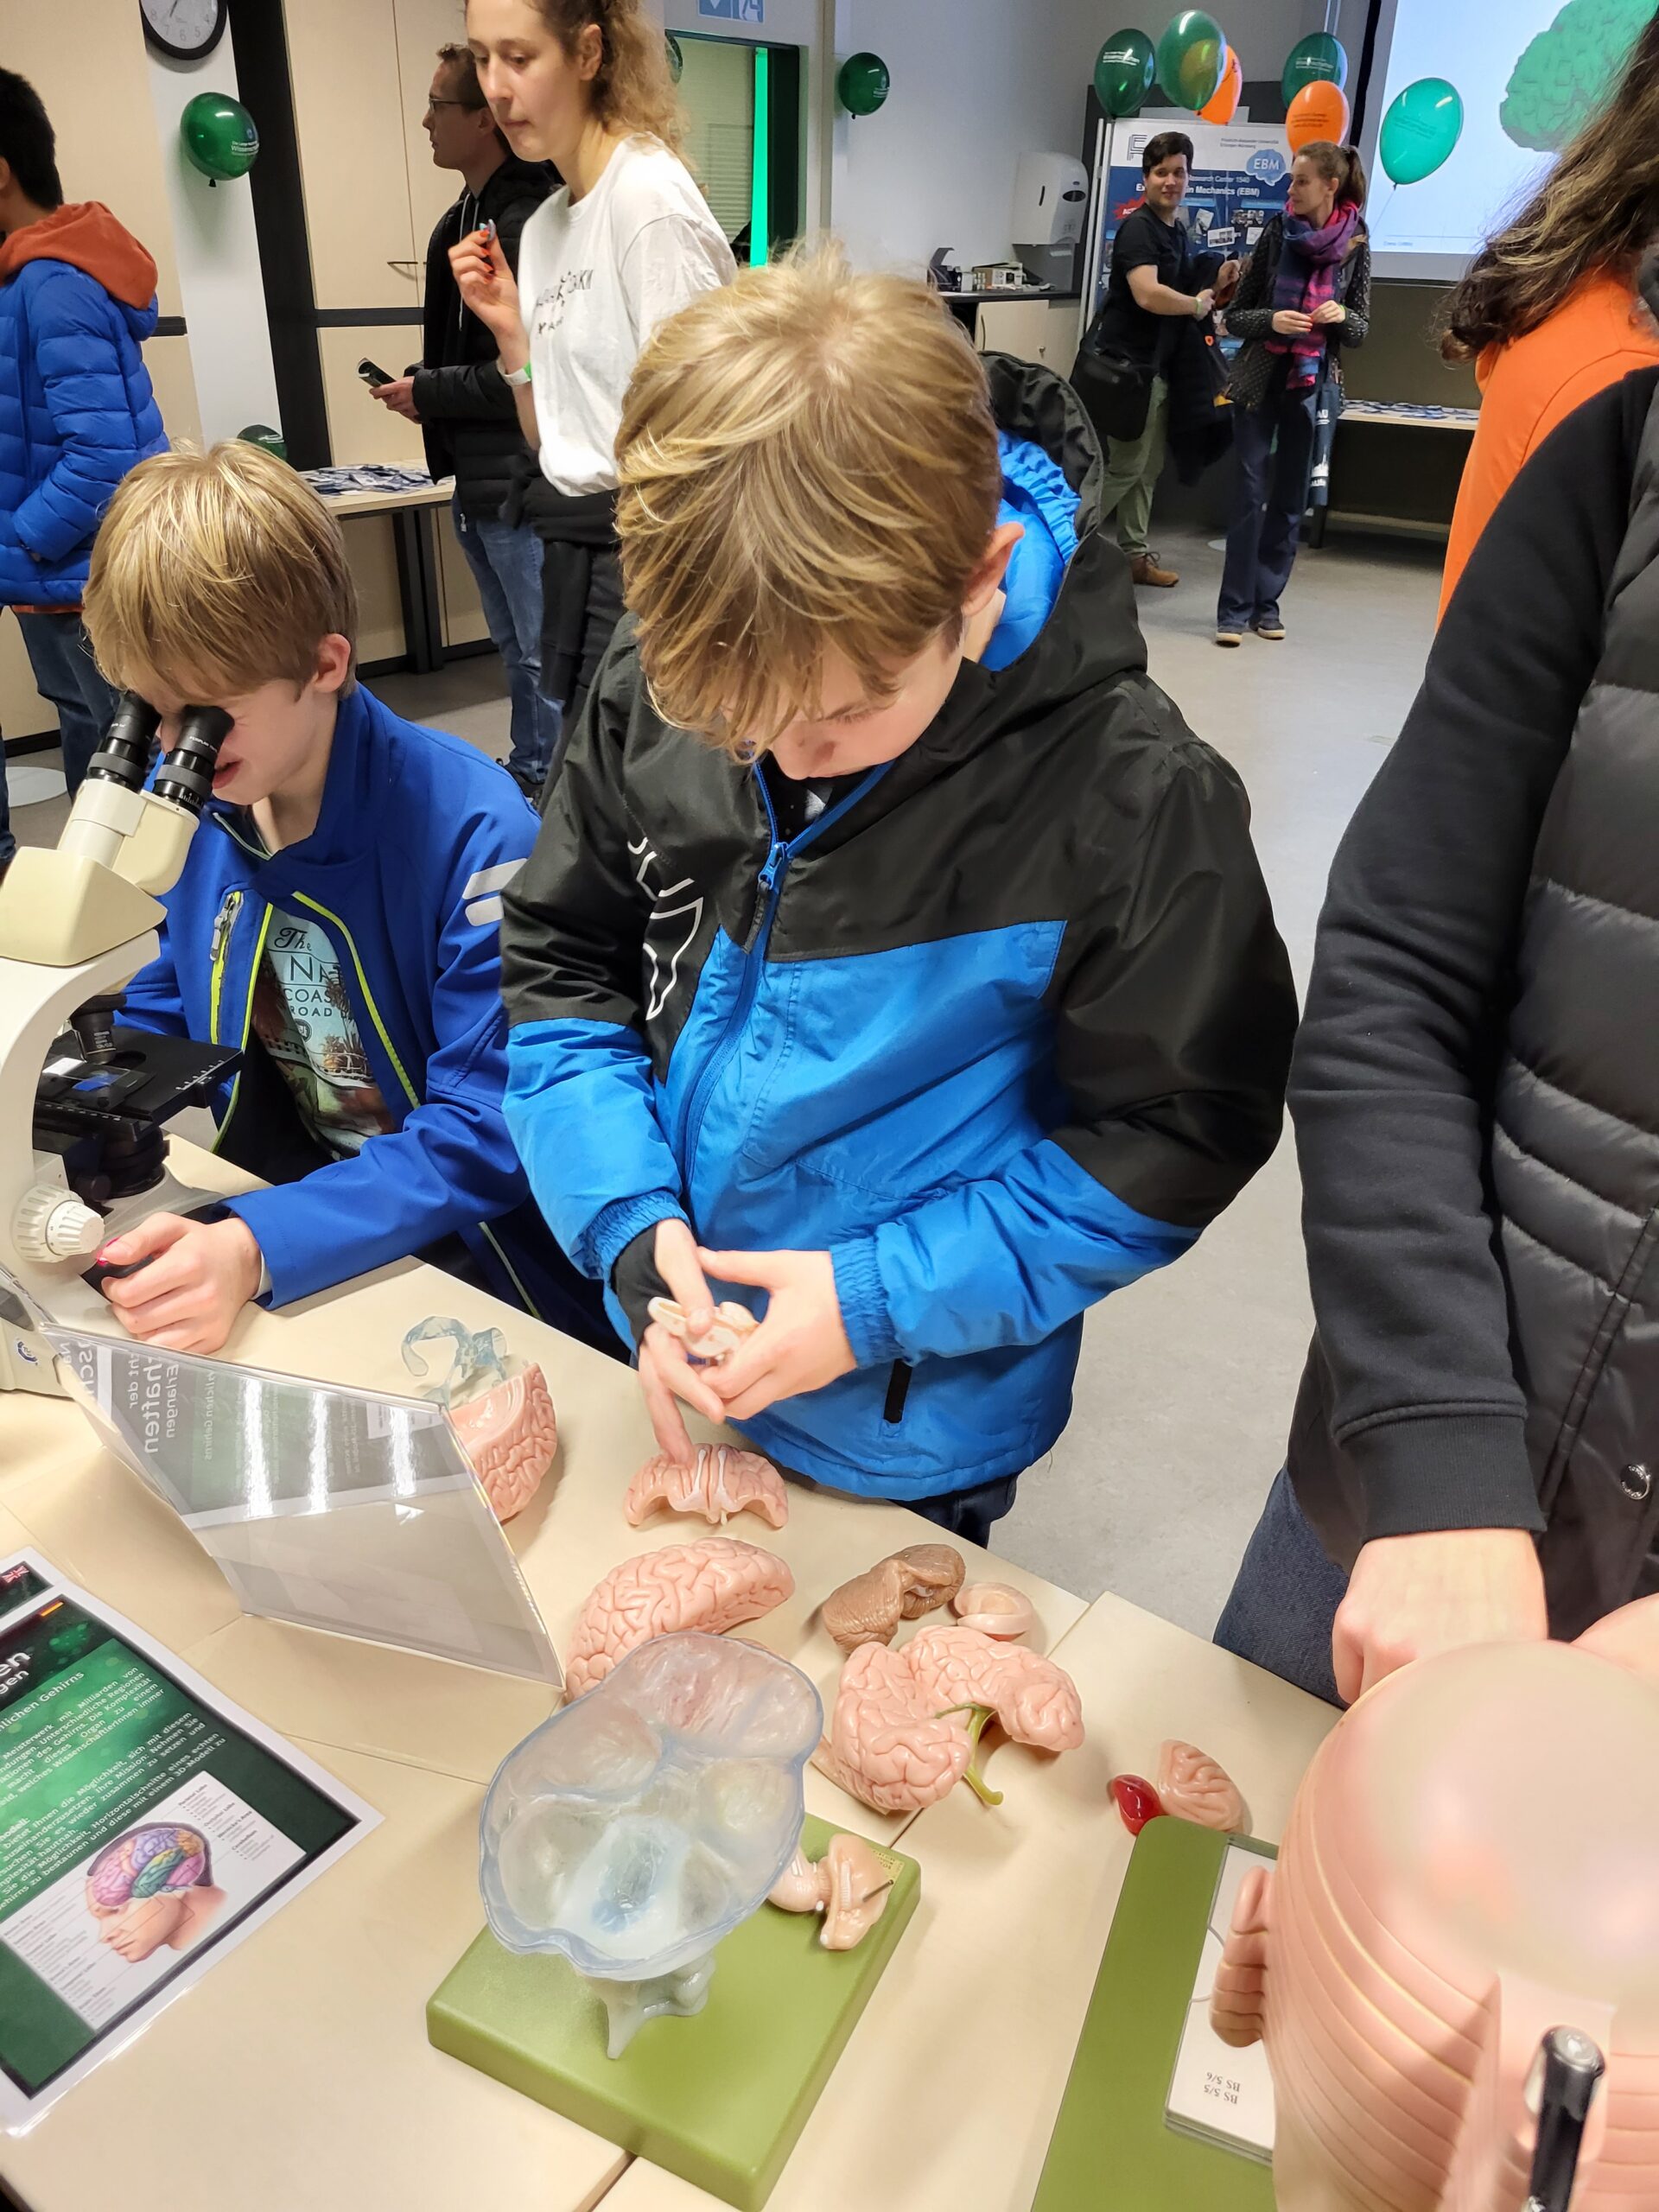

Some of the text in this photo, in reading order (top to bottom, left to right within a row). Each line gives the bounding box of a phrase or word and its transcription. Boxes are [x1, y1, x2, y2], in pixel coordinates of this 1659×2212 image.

[1195, 186, 1236, 195] Mechanics
[1236, 187, 1261, 197] (EBM)
[1254, 158, 1280, 171] EBM
[274, 927, 312, 951] The
[0, 1667, 138, 1760] Meisterwerk mit Milliarden von
[35, 1745, 53, 1758] des
[53, 1723, 88, 1745] Gehirns.
[87, 1711, 104, 1722] Die
[104, 1677, 152, 1711] Komplexität
[37, 1698, 107, 1745] Unterschiedliche
[107, 1673, 145, 1699] Regionen
[39, 1672, 85, 1702] Gehirns
[6, 1683, 158, 1789] macht dieses Organ zu einem
[17, 1768, 53, 1793] welches
[137, 1688, 164, 1708] immer
[1, 1883, 18, 1895] Sie
[21, 1869, 36, 1882] die
[37, 1830, 92, 1869] Möglichkeit,
[92, 1772, 167, 1828] Horizontalschnitte
[168, 1754, 191, 1771] eines
[191, 1733, 219, 1754] echten
[2, 1713, 192, 1849] bietet Ihnen die Möglichkeit, sich mit diesem
[3, 1718, 199, 1862] auseinanderzusetzen. Ihre Mission: Nehmen Sie
[29, 1876, 42, 1886] zu
[41, 1840, 89, 1876] bestaunen
[90, 1826, 108, 1840] und
[109, 1808, 132, 1827] diese
[132, 1796, 149, 1808] mit
[148, 1777, 175, 1796] einem
[173, 1745, 215, 1777] 3D-Modell
[214, 1738, 226, 1747] zu
[35, 1836, 51, 1849] Sie
[54, 1826, 67, 1835] es
[67, 1802, 98, 1825] wieder
[100, 1768, 145, 1802] zusammen
[146, 1758, 158, 1767] zu
[159, 1737, 187, 1757] setzen
[188, 1722, 206, 1736] und
[37, 1829, 79, 1857] hautnah.
[1204, 2084, 1238, 2105] BS 5/5
[1206, 2071, 1241, 2093] BS 5/6
